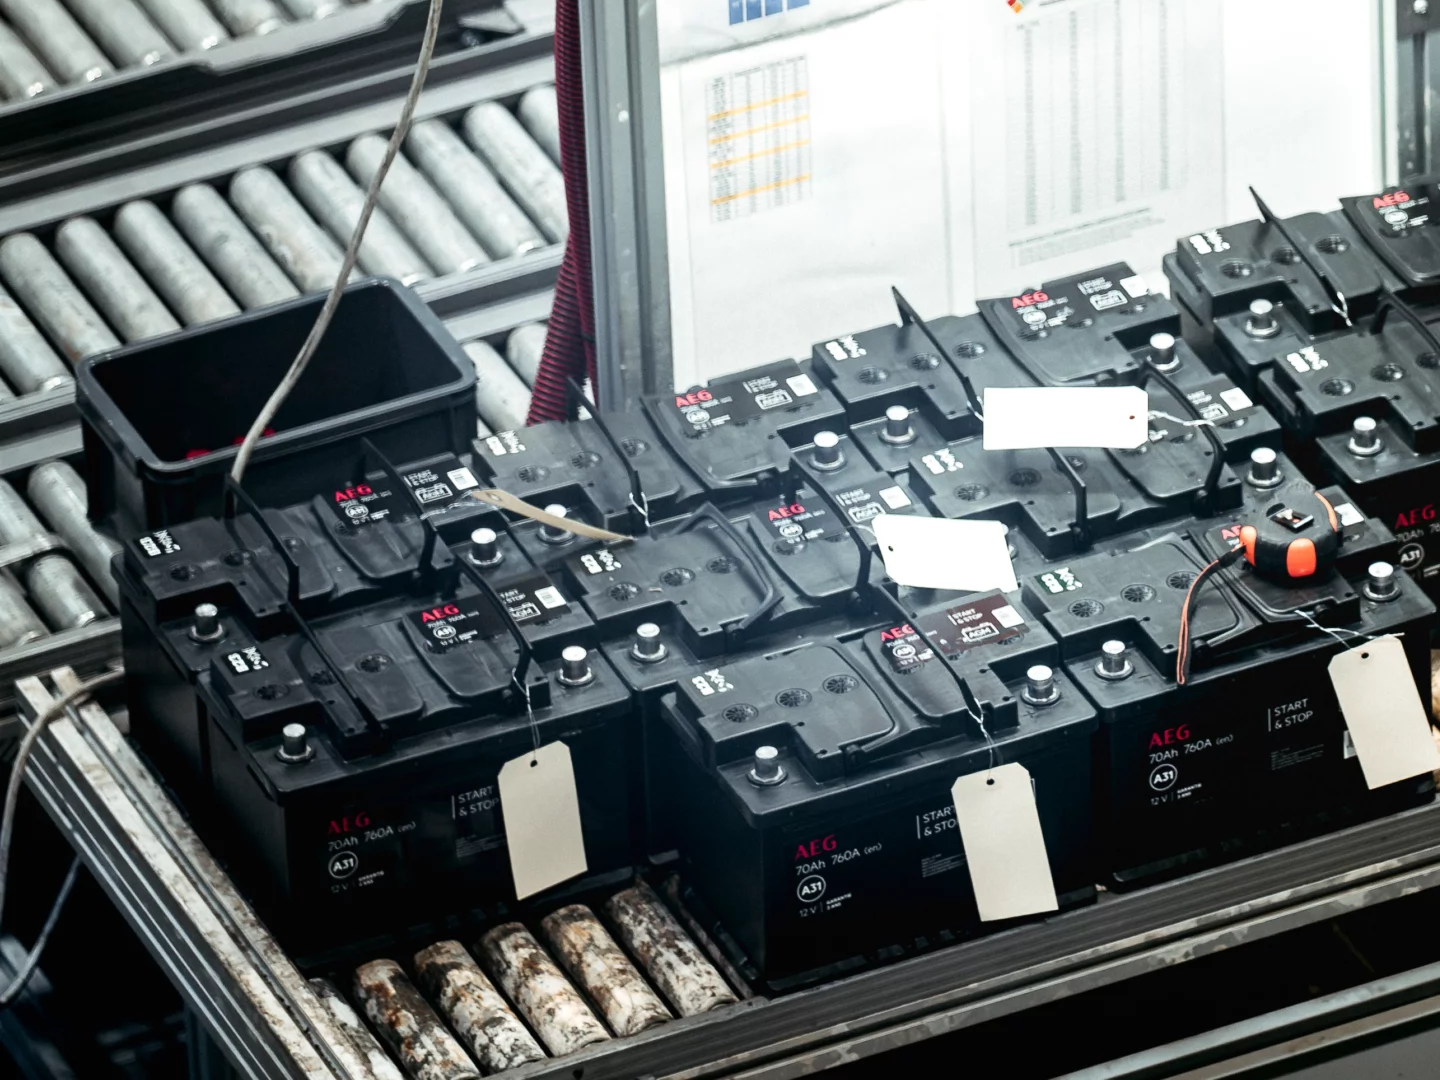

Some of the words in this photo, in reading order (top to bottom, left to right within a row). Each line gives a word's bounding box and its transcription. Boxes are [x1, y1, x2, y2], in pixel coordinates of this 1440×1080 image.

[1011, 290, 1049, 309] AEG
[675, 390, 713, 409] AEG
[334, 484, 372, 503] AEG
[768, 504, 805, 521] AEG
[1394, 504, 1436, 529] AEG
[1401, 550, 1420, 563] A31
[421, 603, 460, 623] AEG
[952, 608, 976, 620] START
[963, 612, 983, 624] STOP
[969, 627, 991, 639] AGM
[1274, 698, 1309, 717] START
[1274, 719, 1283, 730] &
[1284, 710, 1313, 727] STOP
[1148, 724, 1191, 749] AEG
[1149, 749, 1179, 764] 70Ah
[1183, 737, 1213, 755] 760A
[1153, 770, 1175, 784] A31
[458, 785, 494, 804] START
[459, 806, 468, 817] &
[470, 797, 499, 814] STOP
[327, 811, 370, 836] AEG
[924, 826, 932, 836] &
[934, 818, 957, 833] STO
[327, 836, 359, 852] 70Ah
[363, 826, 394, 843] 760A
[794, 834, 837, 861] AEG
[332, 858, 355, 872] A31
[795, 859, 826, 875] 70Ah
[831, 847, 861, 865] 760A
[864, 842, 882, 856] (en)
[801, 881, 822, 896] A31
